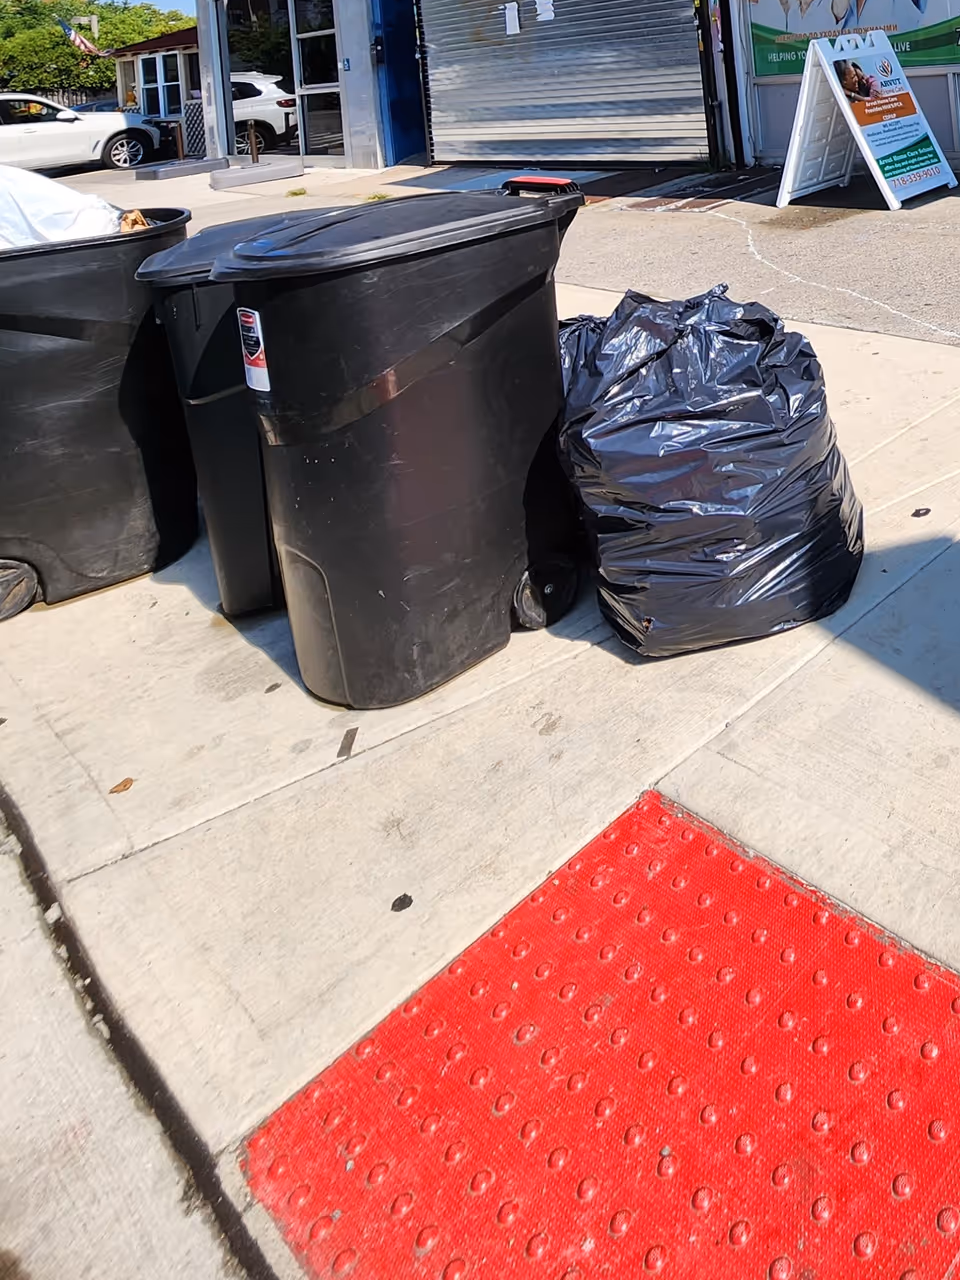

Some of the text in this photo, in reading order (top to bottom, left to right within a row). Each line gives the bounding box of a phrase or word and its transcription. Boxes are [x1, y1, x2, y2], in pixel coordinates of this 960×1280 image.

[768, 52, 796, 62] HELPING
[894, 41, 911, 52] LIVE
[880, 77, 902, 88] ARVUT
[892, 166, 941, 188] 718-339-9010
